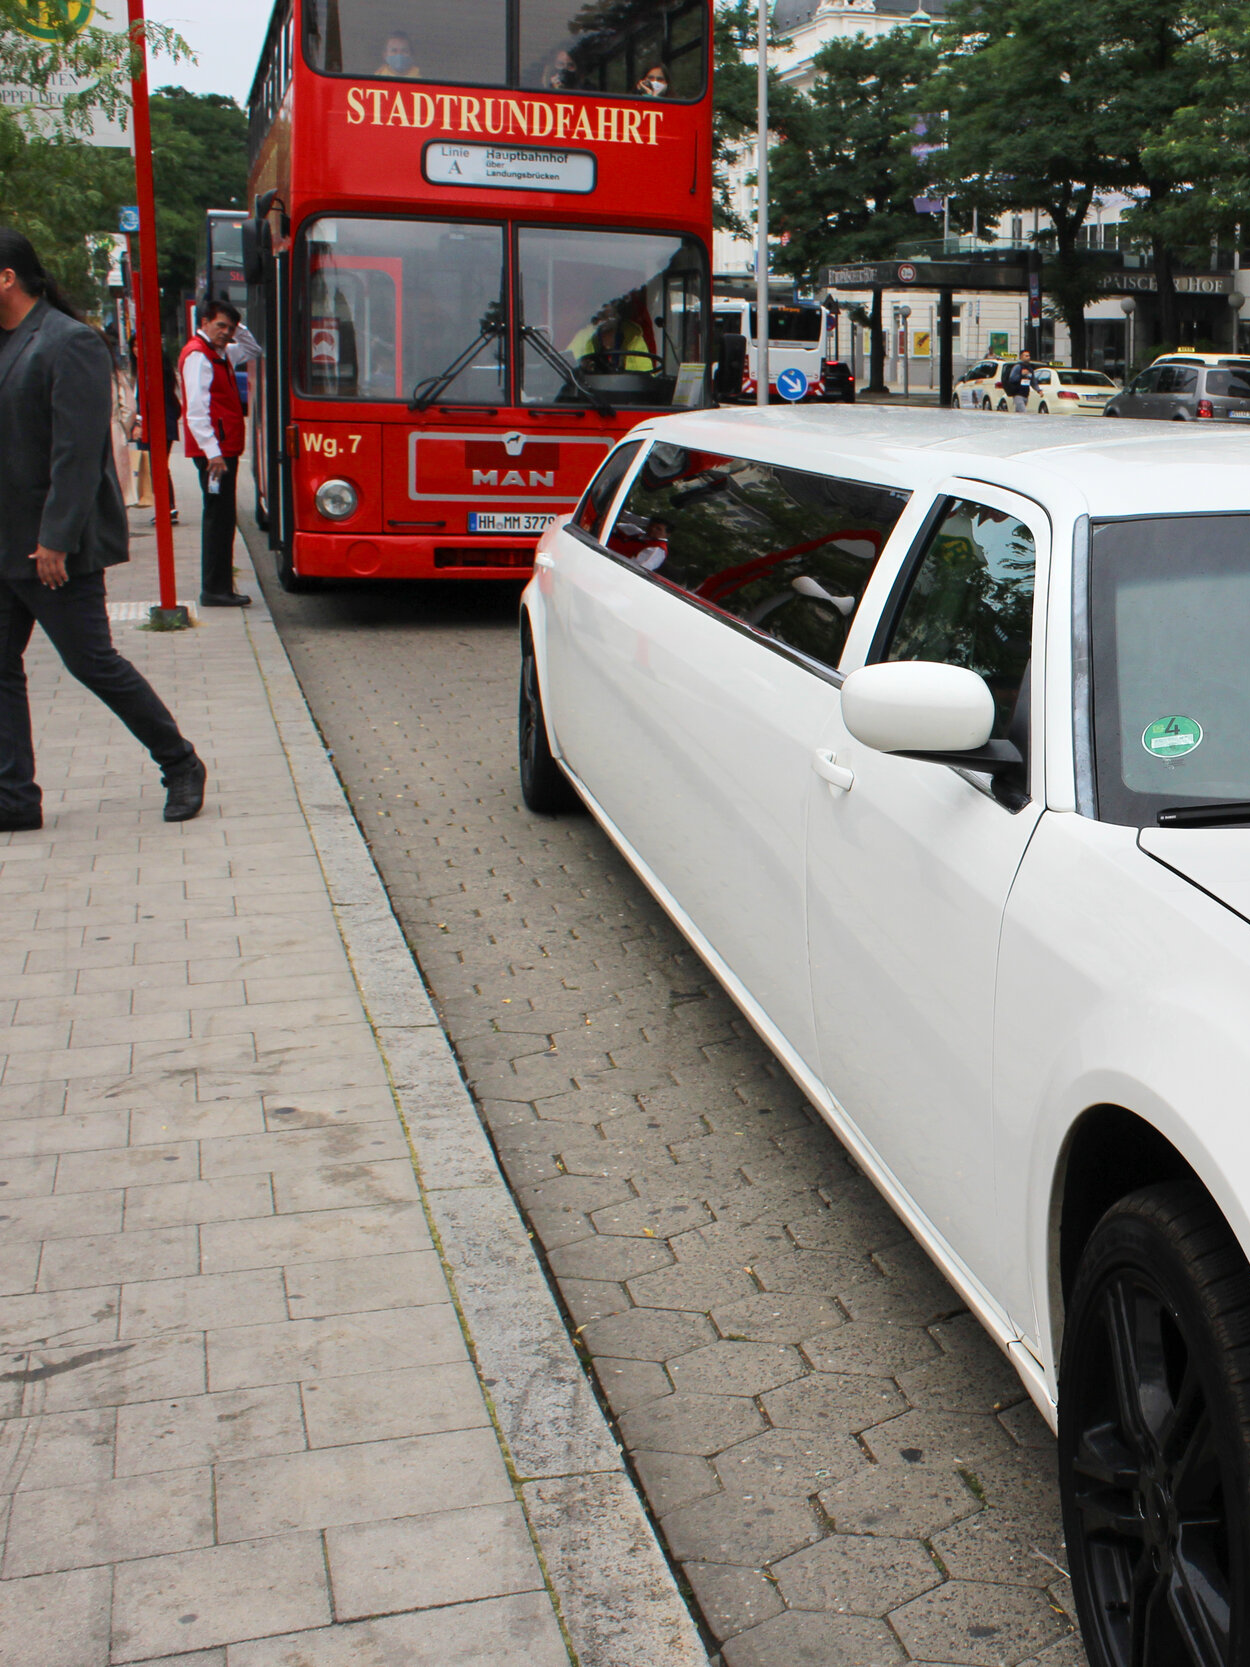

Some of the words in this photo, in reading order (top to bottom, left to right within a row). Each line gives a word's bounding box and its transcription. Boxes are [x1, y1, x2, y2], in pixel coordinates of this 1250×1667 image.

[347, 87, 663, 145] STADTRUNDFAHRT
[441, 146, 470, 158] Linie
[486, 150, 569, 164] Hauptbahnhof
[449, 160, 463, 175] A
[486, 161, 505, 169] über
[486, 170, 560, 181] Landungsbrücken
[1188, 277, 1224, 293] HOF
[303, 432, 344, 457] Wg.
[348, 435, 362, 453] 7
[472, 469, 555, 487] MAN
[478, 515, 495, 529] HH
[504, 516, 520, 529] MM
[1165, 717, 1180, 735] 4
